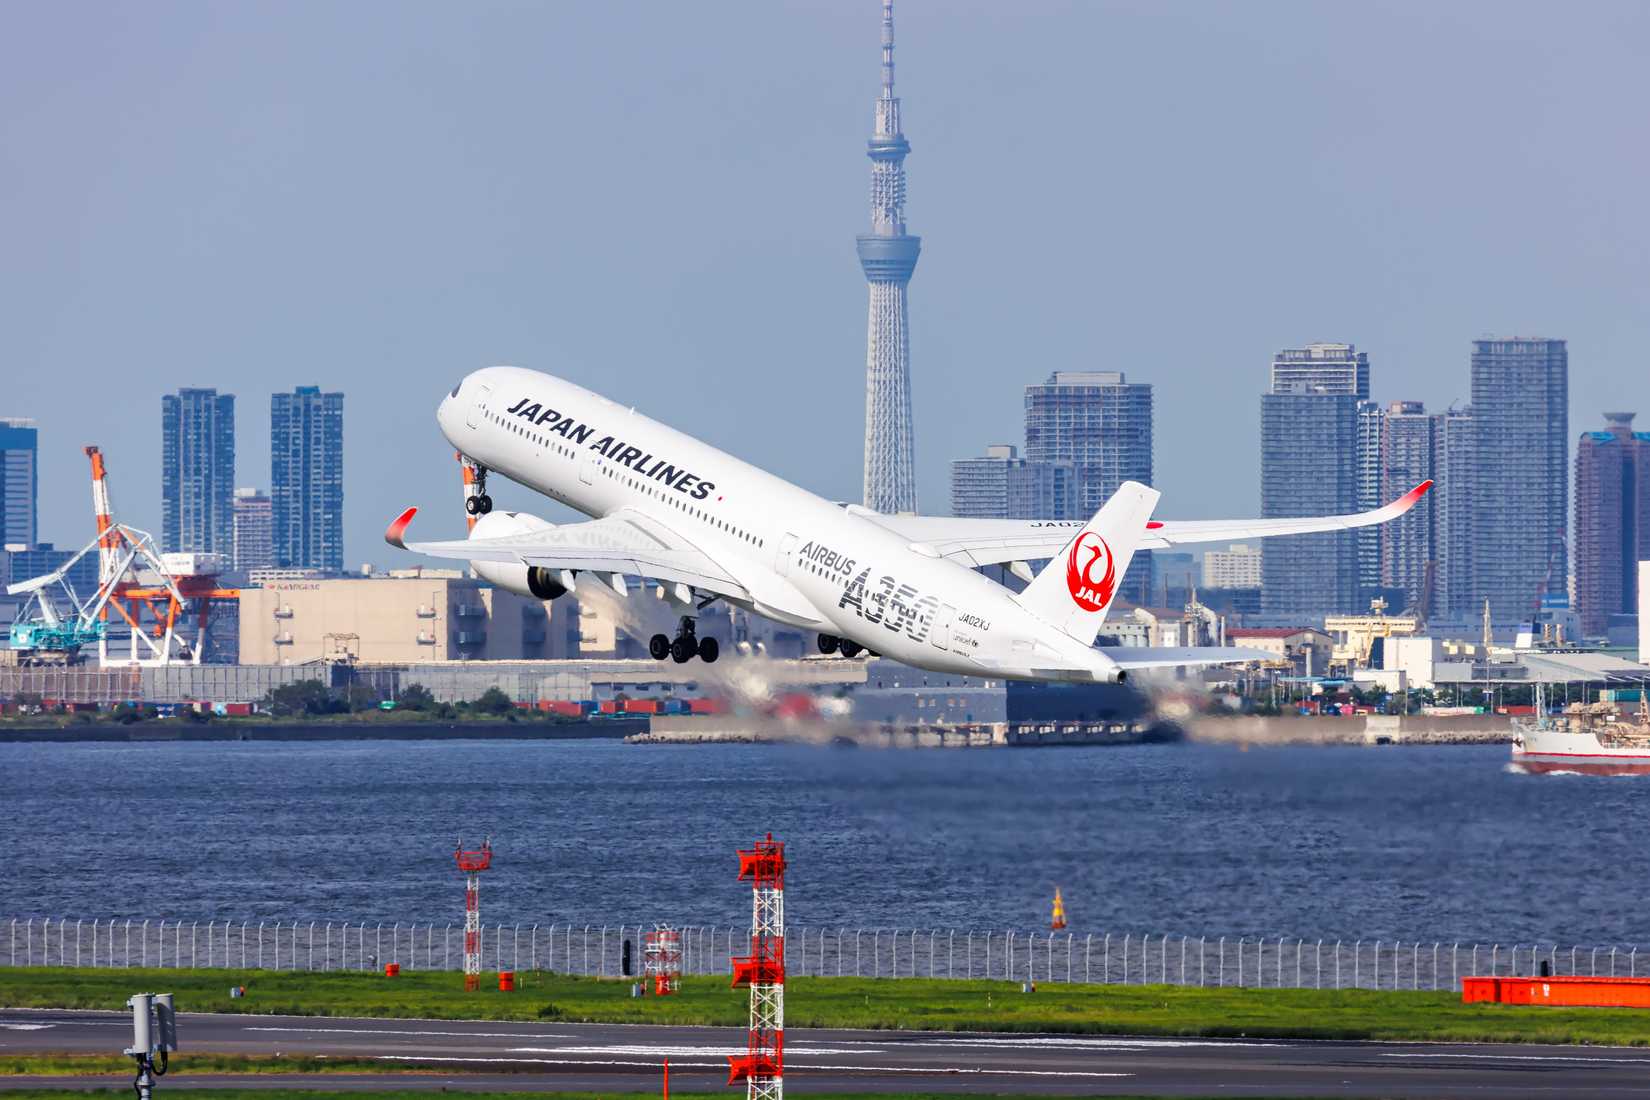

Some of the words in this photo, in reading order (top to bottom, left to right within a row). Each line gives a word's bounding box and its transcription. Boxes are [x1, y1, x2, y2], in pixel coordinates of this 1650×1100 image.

[507, 398, 594, 445] JAPAN
[590, 435, 716, 500] AIRLINES
[800, 541, 857, 576] AIRBUS
[838, 567, 939, 643] A350
[1075, 586, 1103, 607] JAL
[958, 612, 991, 631] JA02XJ
